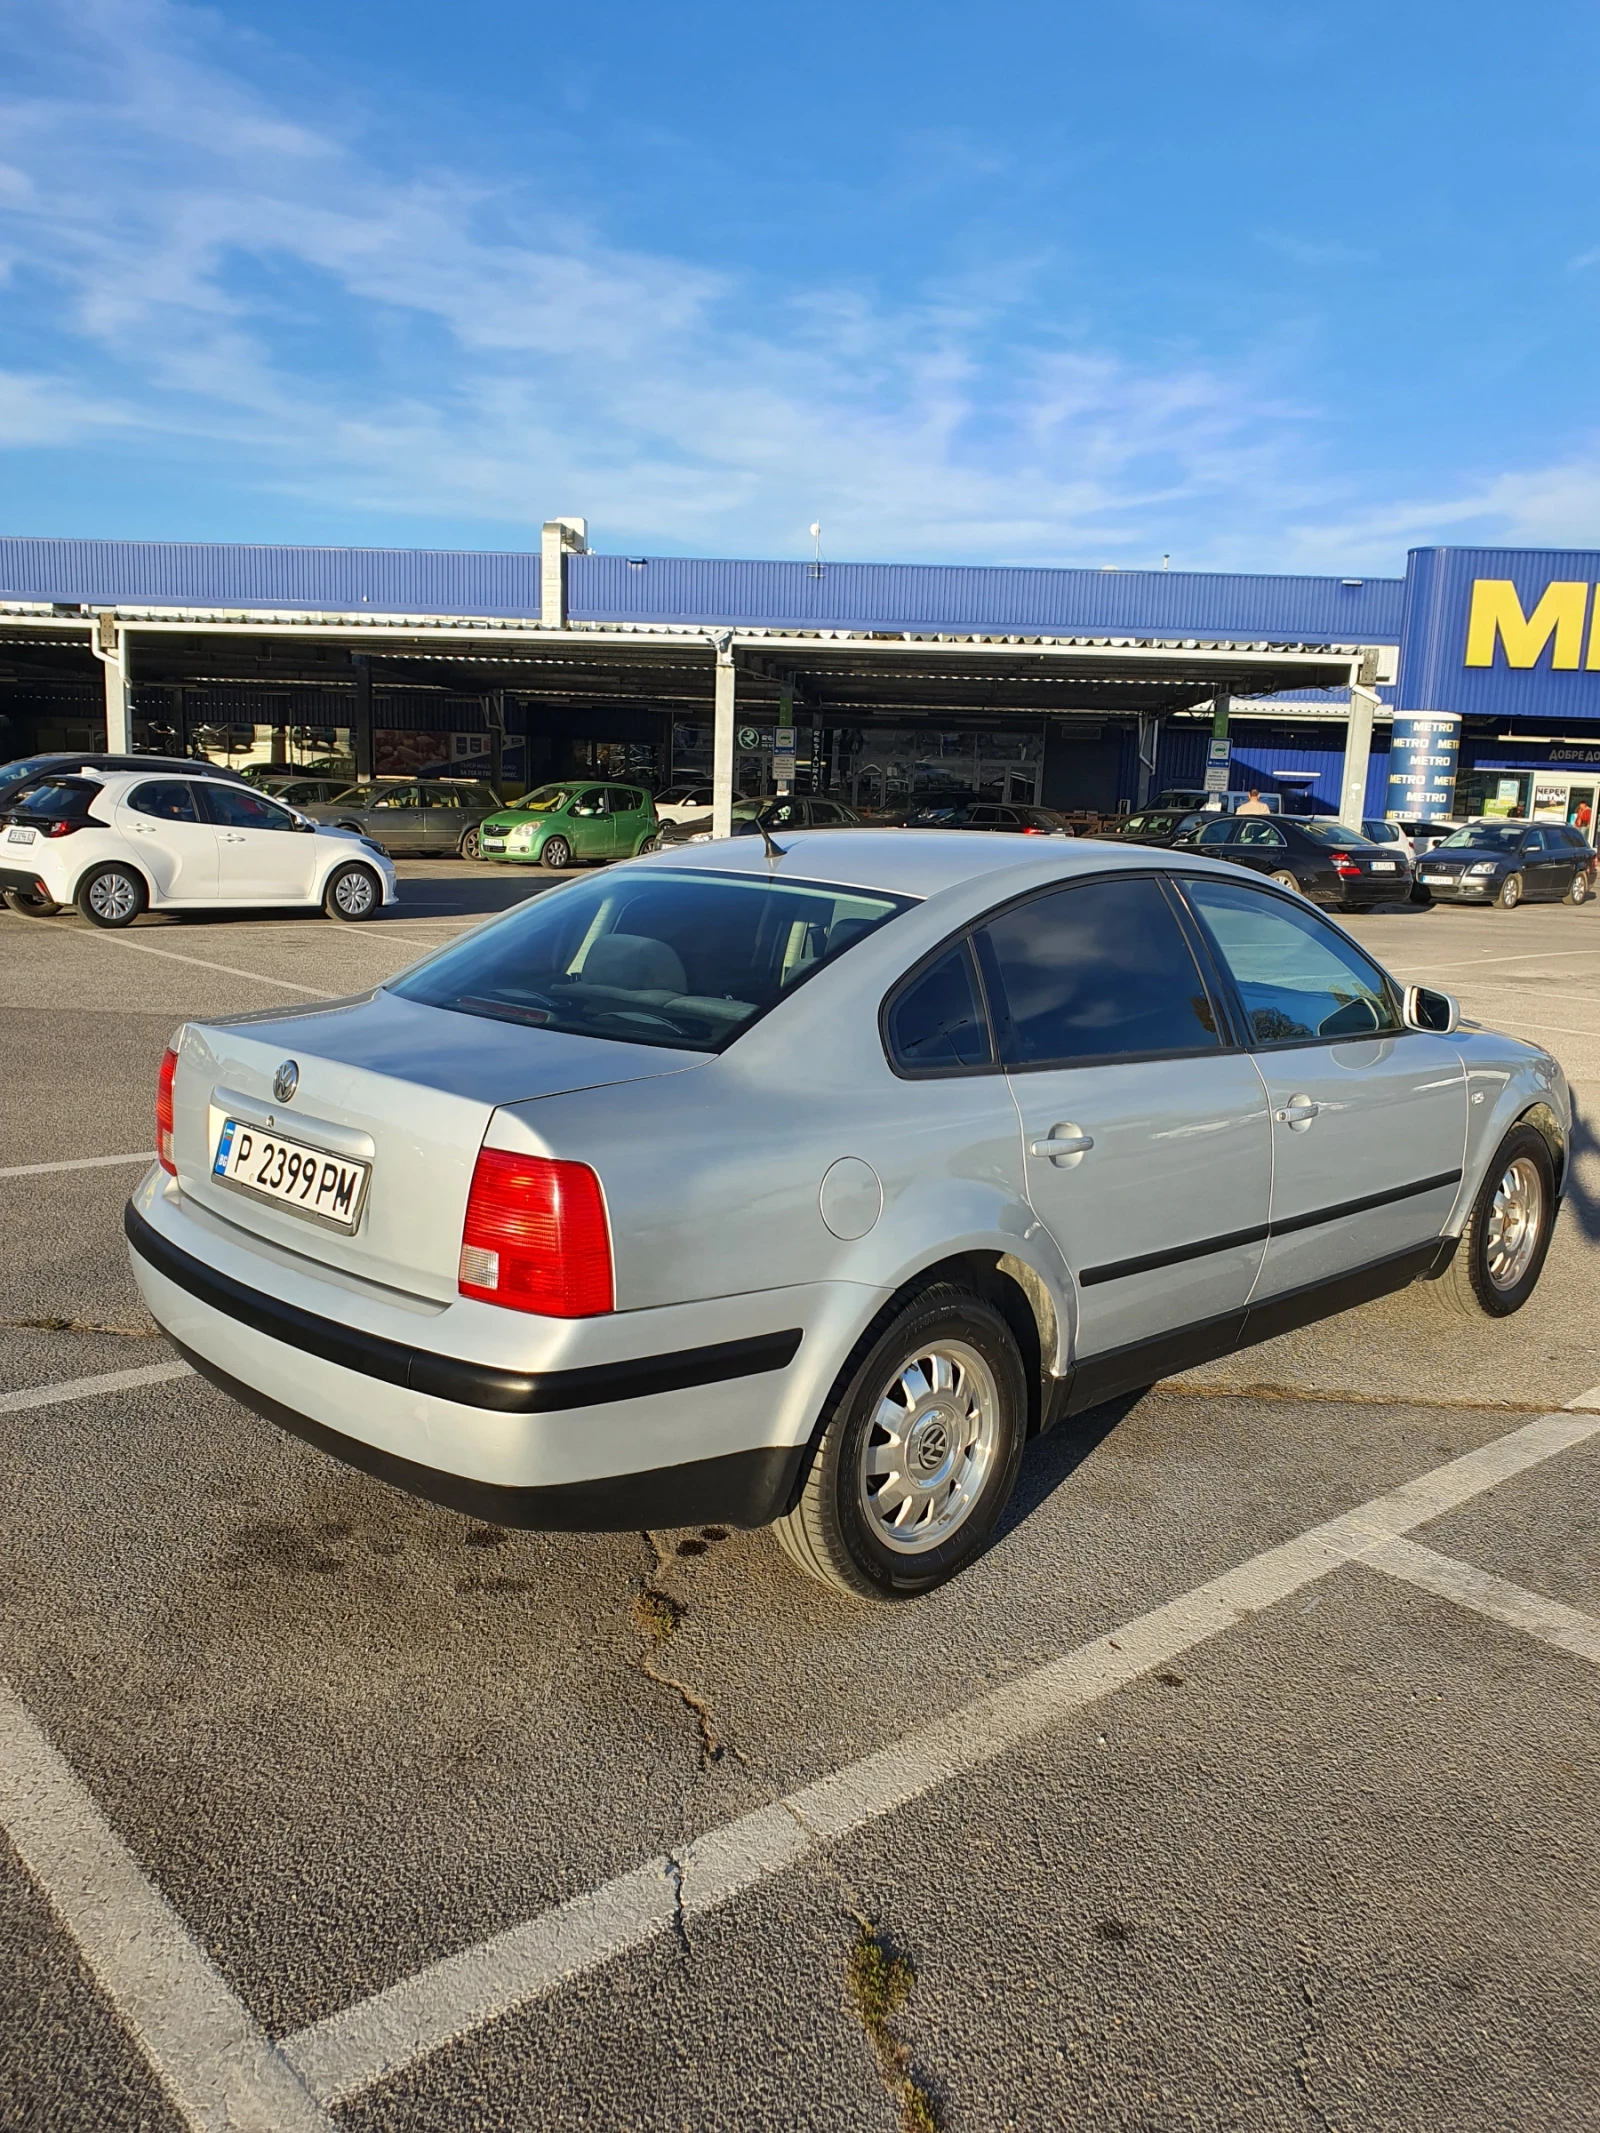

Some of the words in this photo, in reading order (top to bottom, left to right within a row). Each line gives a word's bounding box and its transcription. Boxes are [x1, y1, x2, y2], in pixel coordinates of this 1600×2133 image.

[1464, 579, 1600, 671] M
[1413, 722, 1453, 732] METRO
[1393, 738, 1429, 748] METRO
[1549, 749, 1584, 761] ДОБРЕ
[812, 730, 820, 793] RESTAURANT
[1410, 756, 1450, 766] METRO
[1389, 774, 1426, 785] METRO
[1406, 792, 1447, 803] METRO
[1537, 788, 1566, 797] ЧЕРЕН
[1386, 810, 1422, 820] METRO
